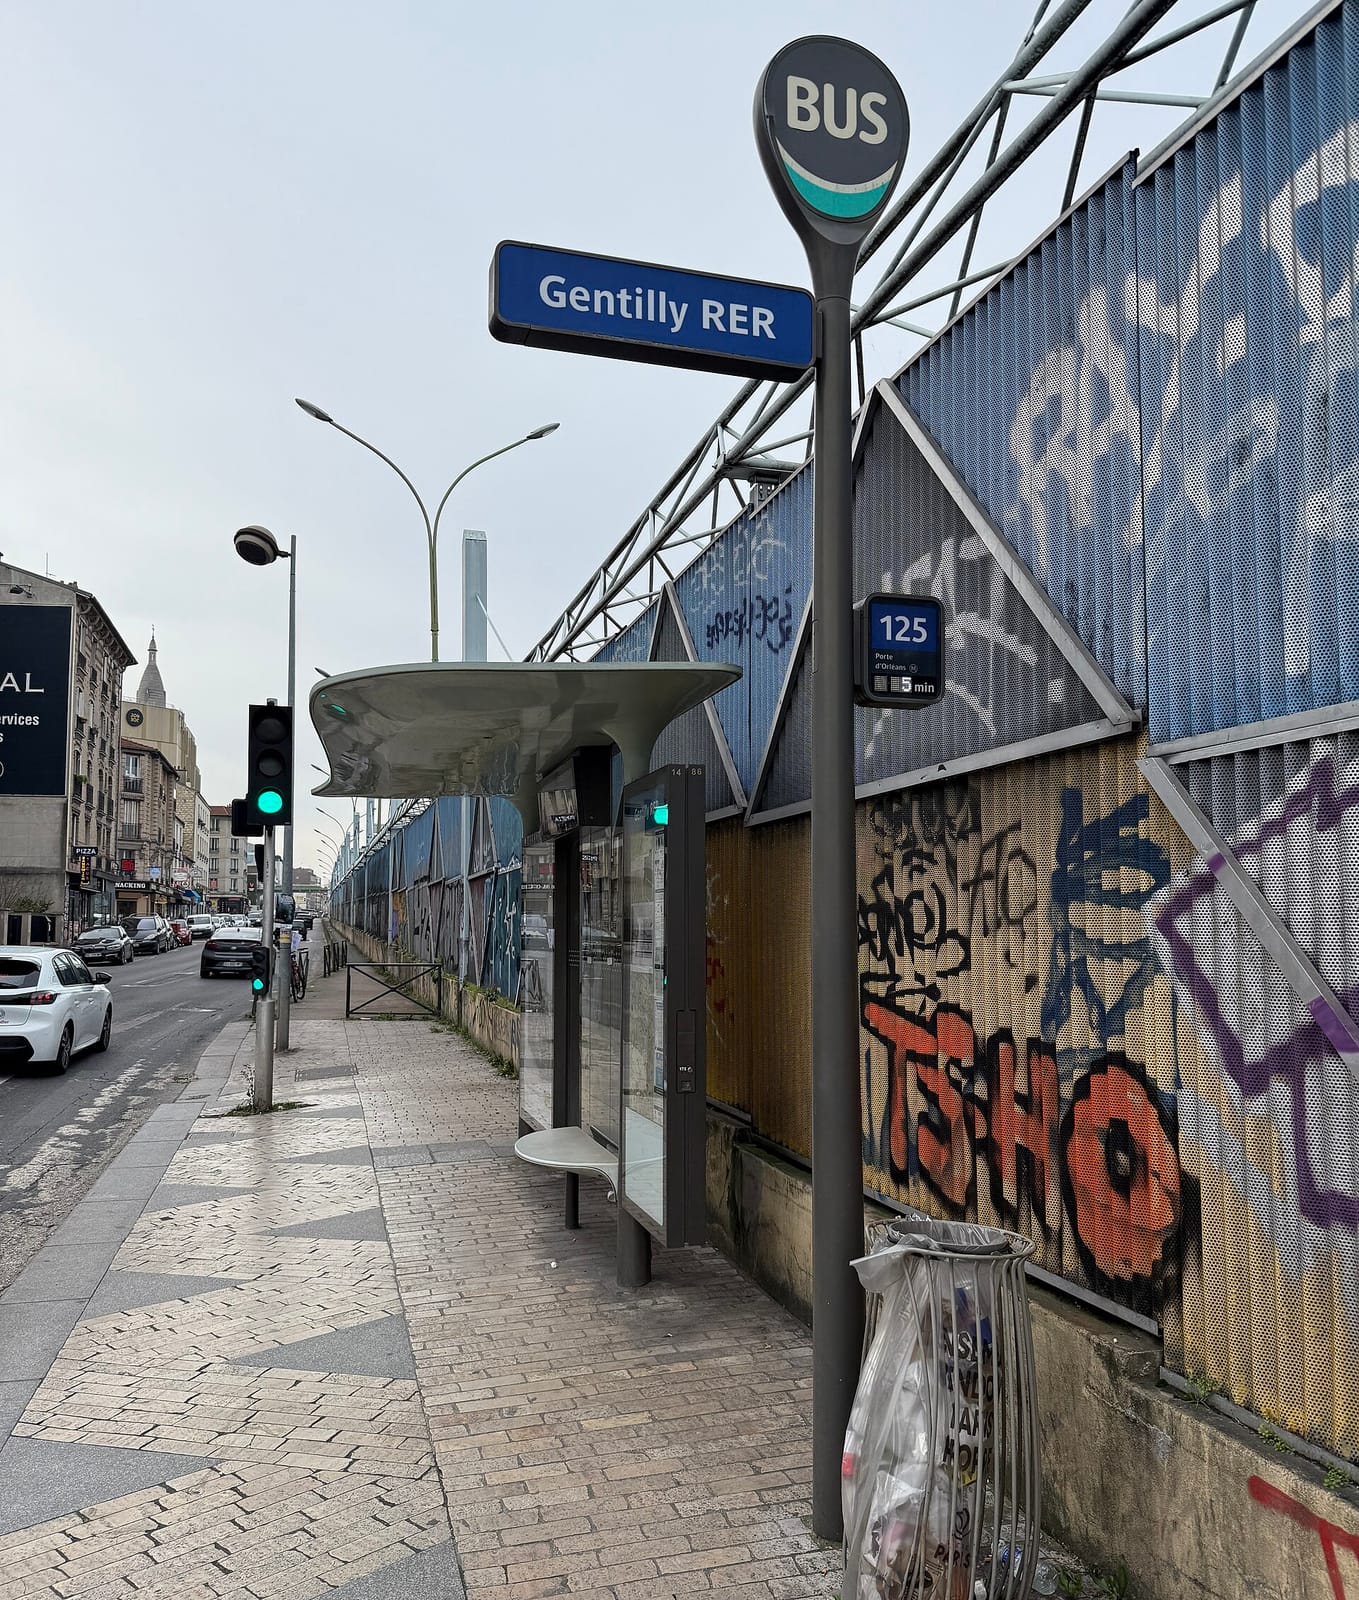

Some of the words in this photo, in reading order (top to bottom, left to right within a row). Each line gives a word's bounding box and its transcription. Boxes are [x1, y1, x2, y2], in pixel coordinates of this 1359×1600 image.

[786, 75, 888, 145] BUS
[538, 275, 689, 333] Gentilly
[702, 299, 777, 340] RER
[880, 615, 928, 643] 125
[875, 652, 894, 661] Porte
[0, 672, 45, 693] AL
[901, 676, 912, 692] 5
[914, 682, 935, 693] min
[671, 768, 682, 776] 14
[691, 767, 702, 776] 86
[114, 882, 146, 890] NACKING
